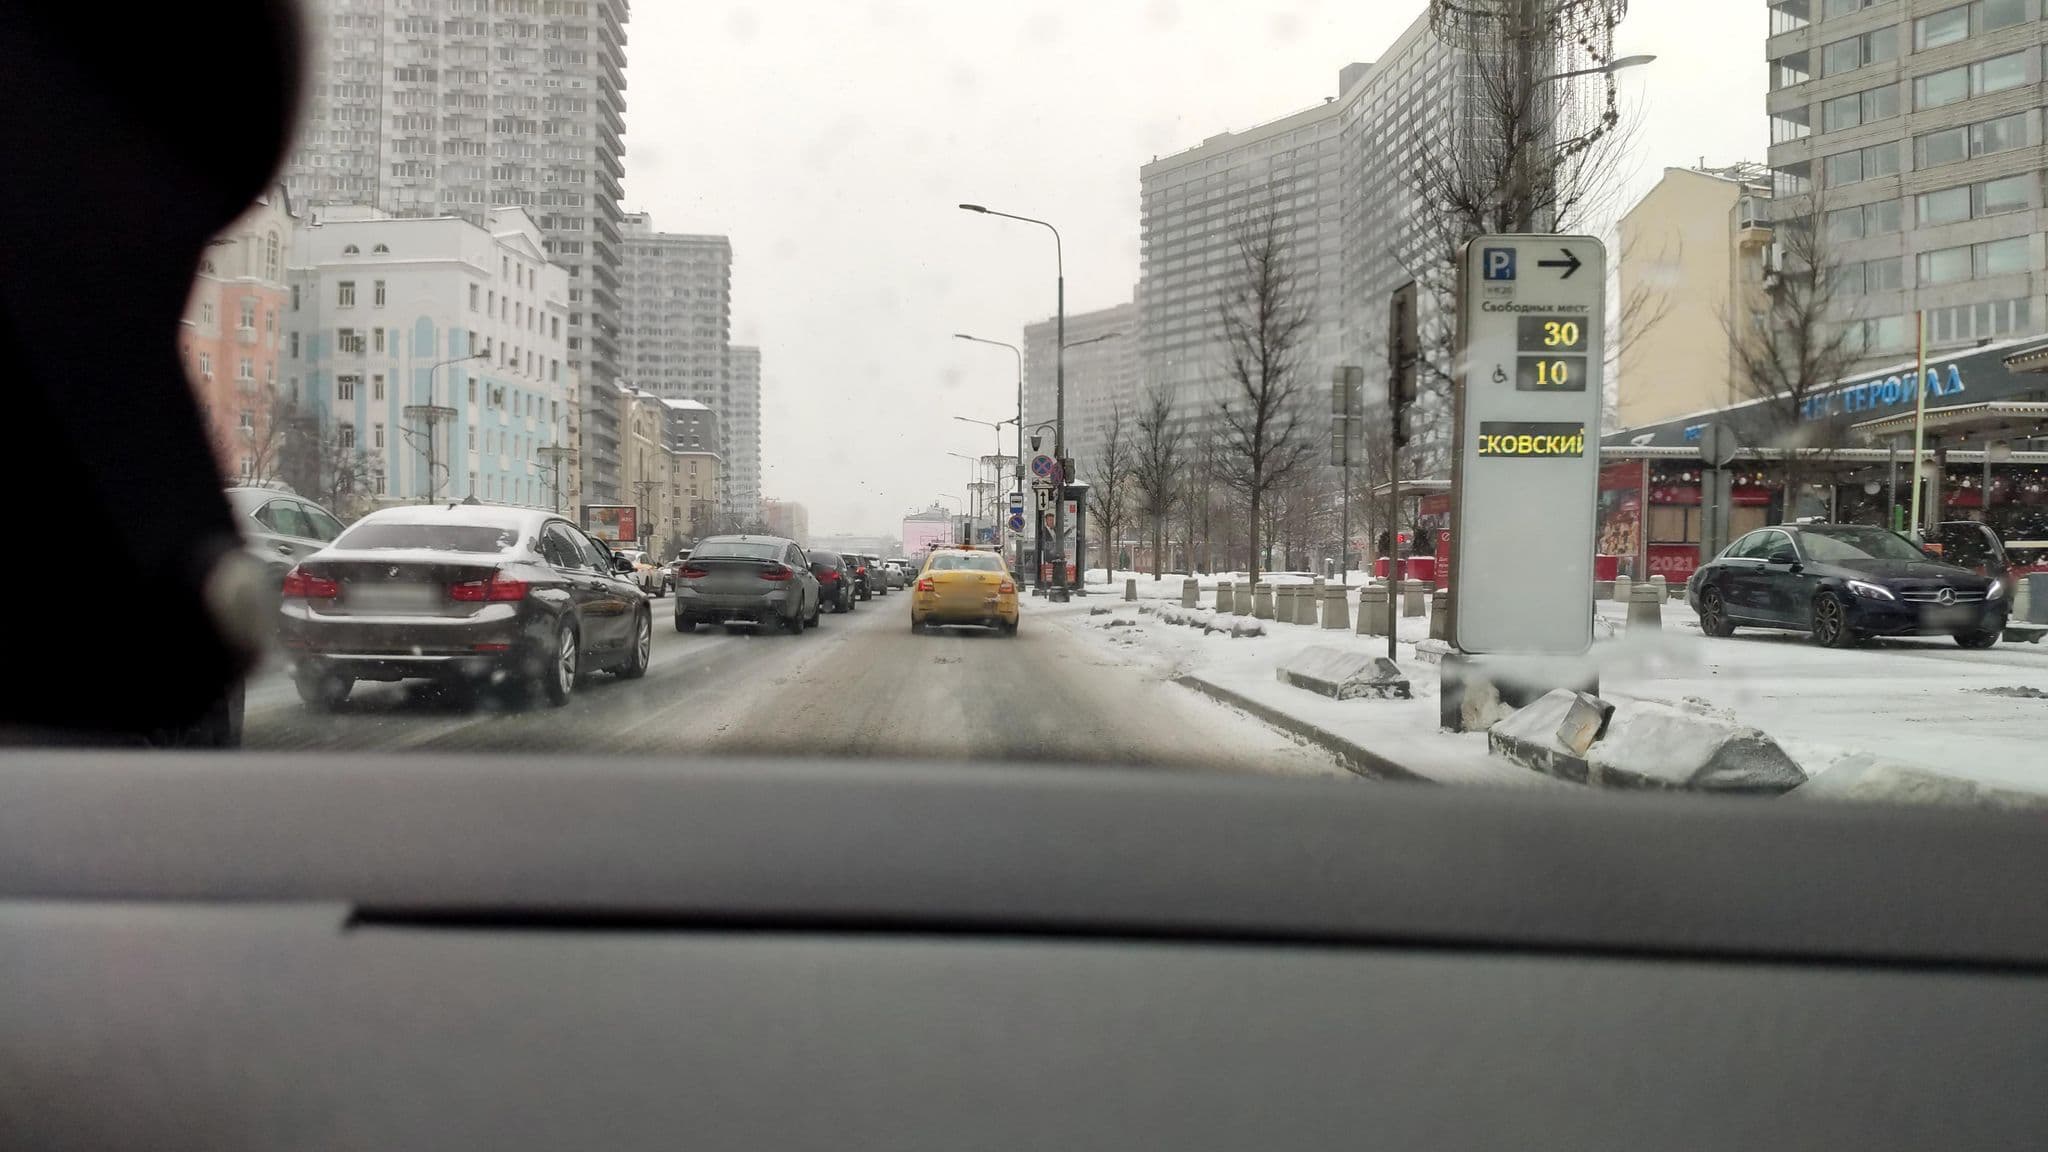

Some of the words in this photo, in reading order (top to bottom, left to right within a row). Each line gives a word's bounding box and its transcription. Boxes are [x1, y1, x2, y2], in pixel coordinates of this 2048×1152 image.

[1481, 300, 1554, 313] Свободных
[1543, 321, 1580, 346] 30
[1536, 360, 1568, 385] 10
[1648, 555, 1693, 572] 2021
